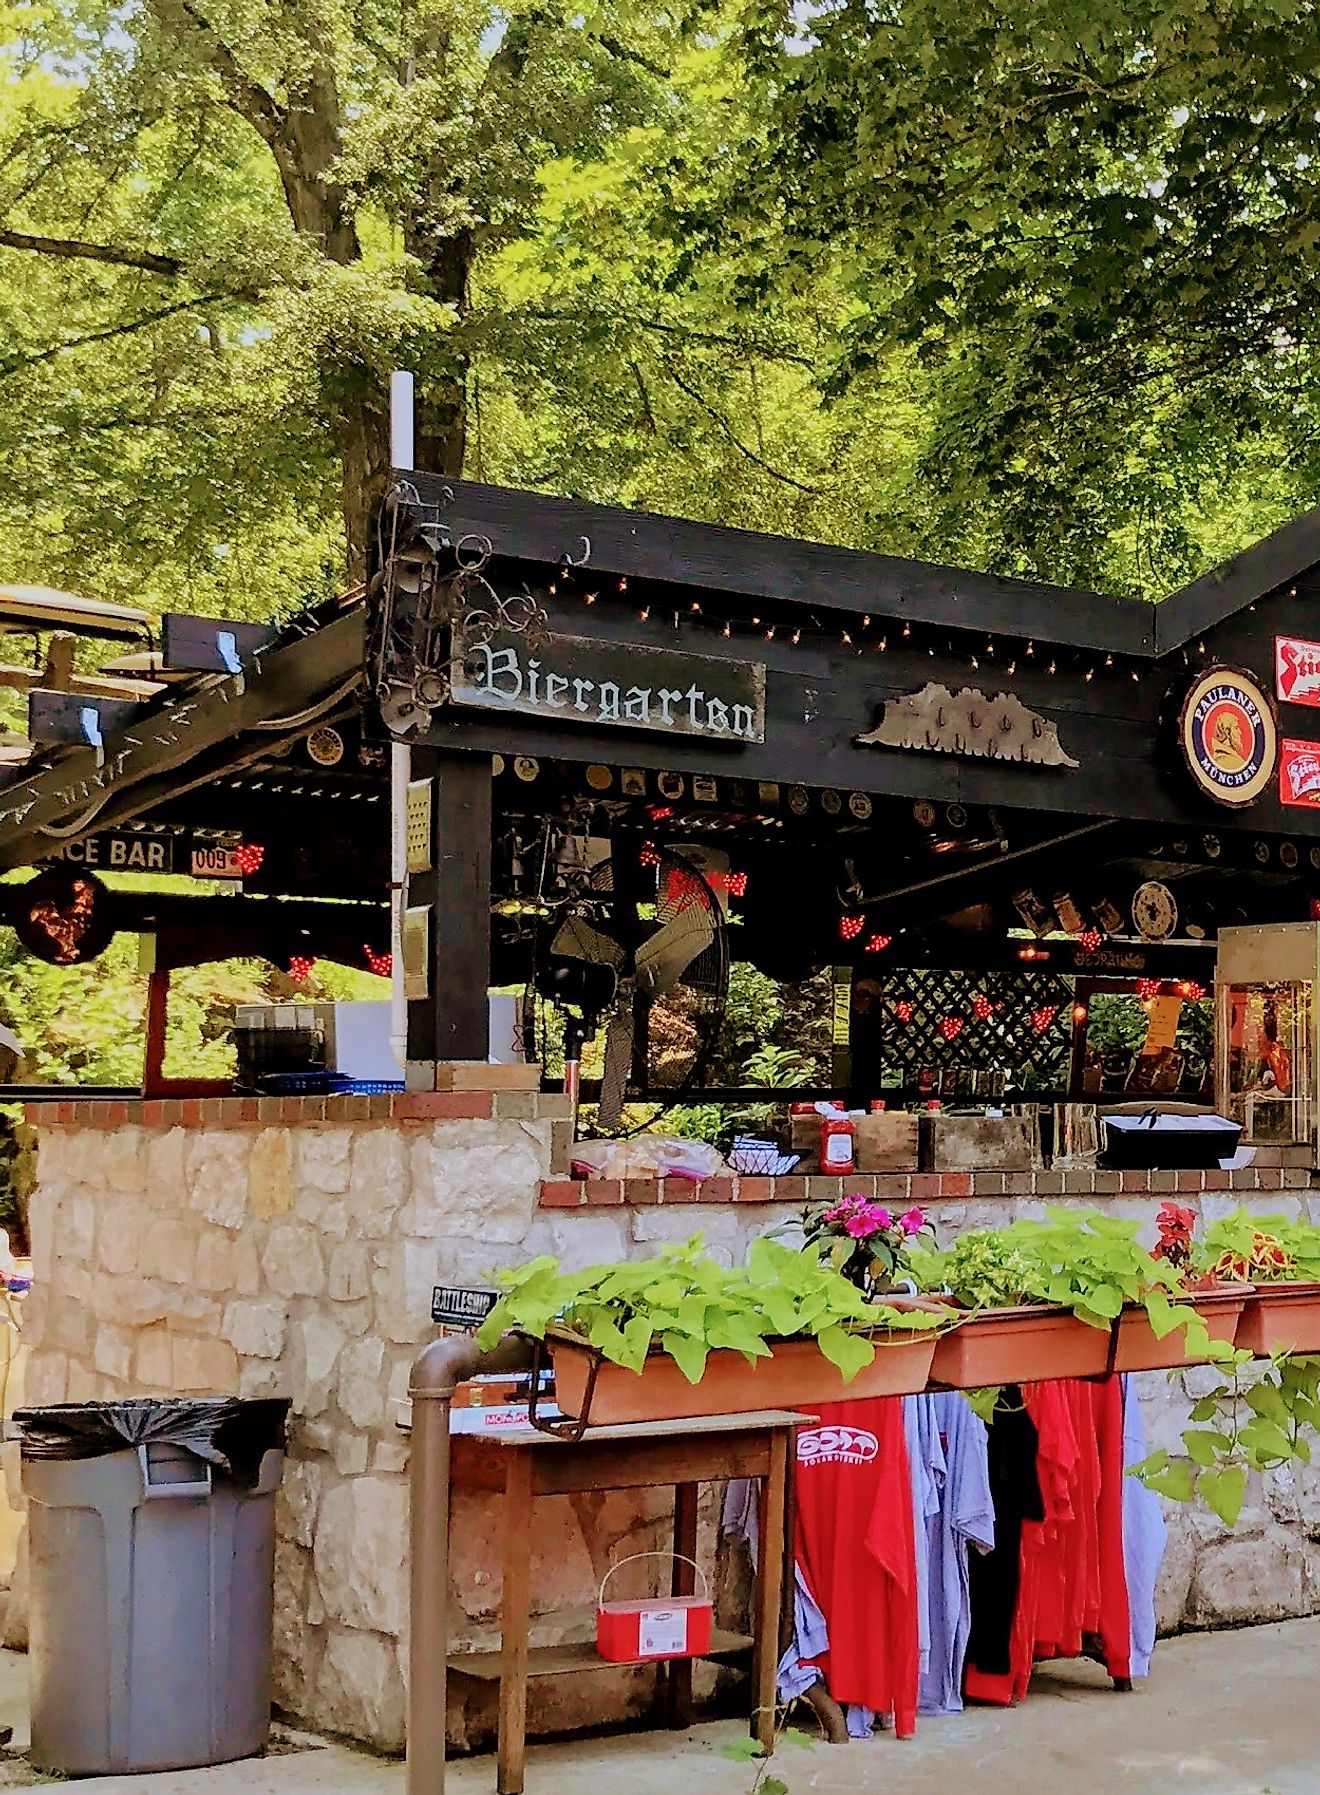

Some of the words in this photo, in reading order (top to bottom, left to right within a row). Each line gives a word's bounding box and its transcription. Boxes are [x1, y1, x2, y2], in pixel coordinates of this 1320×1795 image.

[469, 642, 755, 738] Biergarten
[1195, 687, 1261, 728] PAULANER
[109, 839, 165, 869] BAR
[433, 1287, 491, 1315] BATTLESHIP
